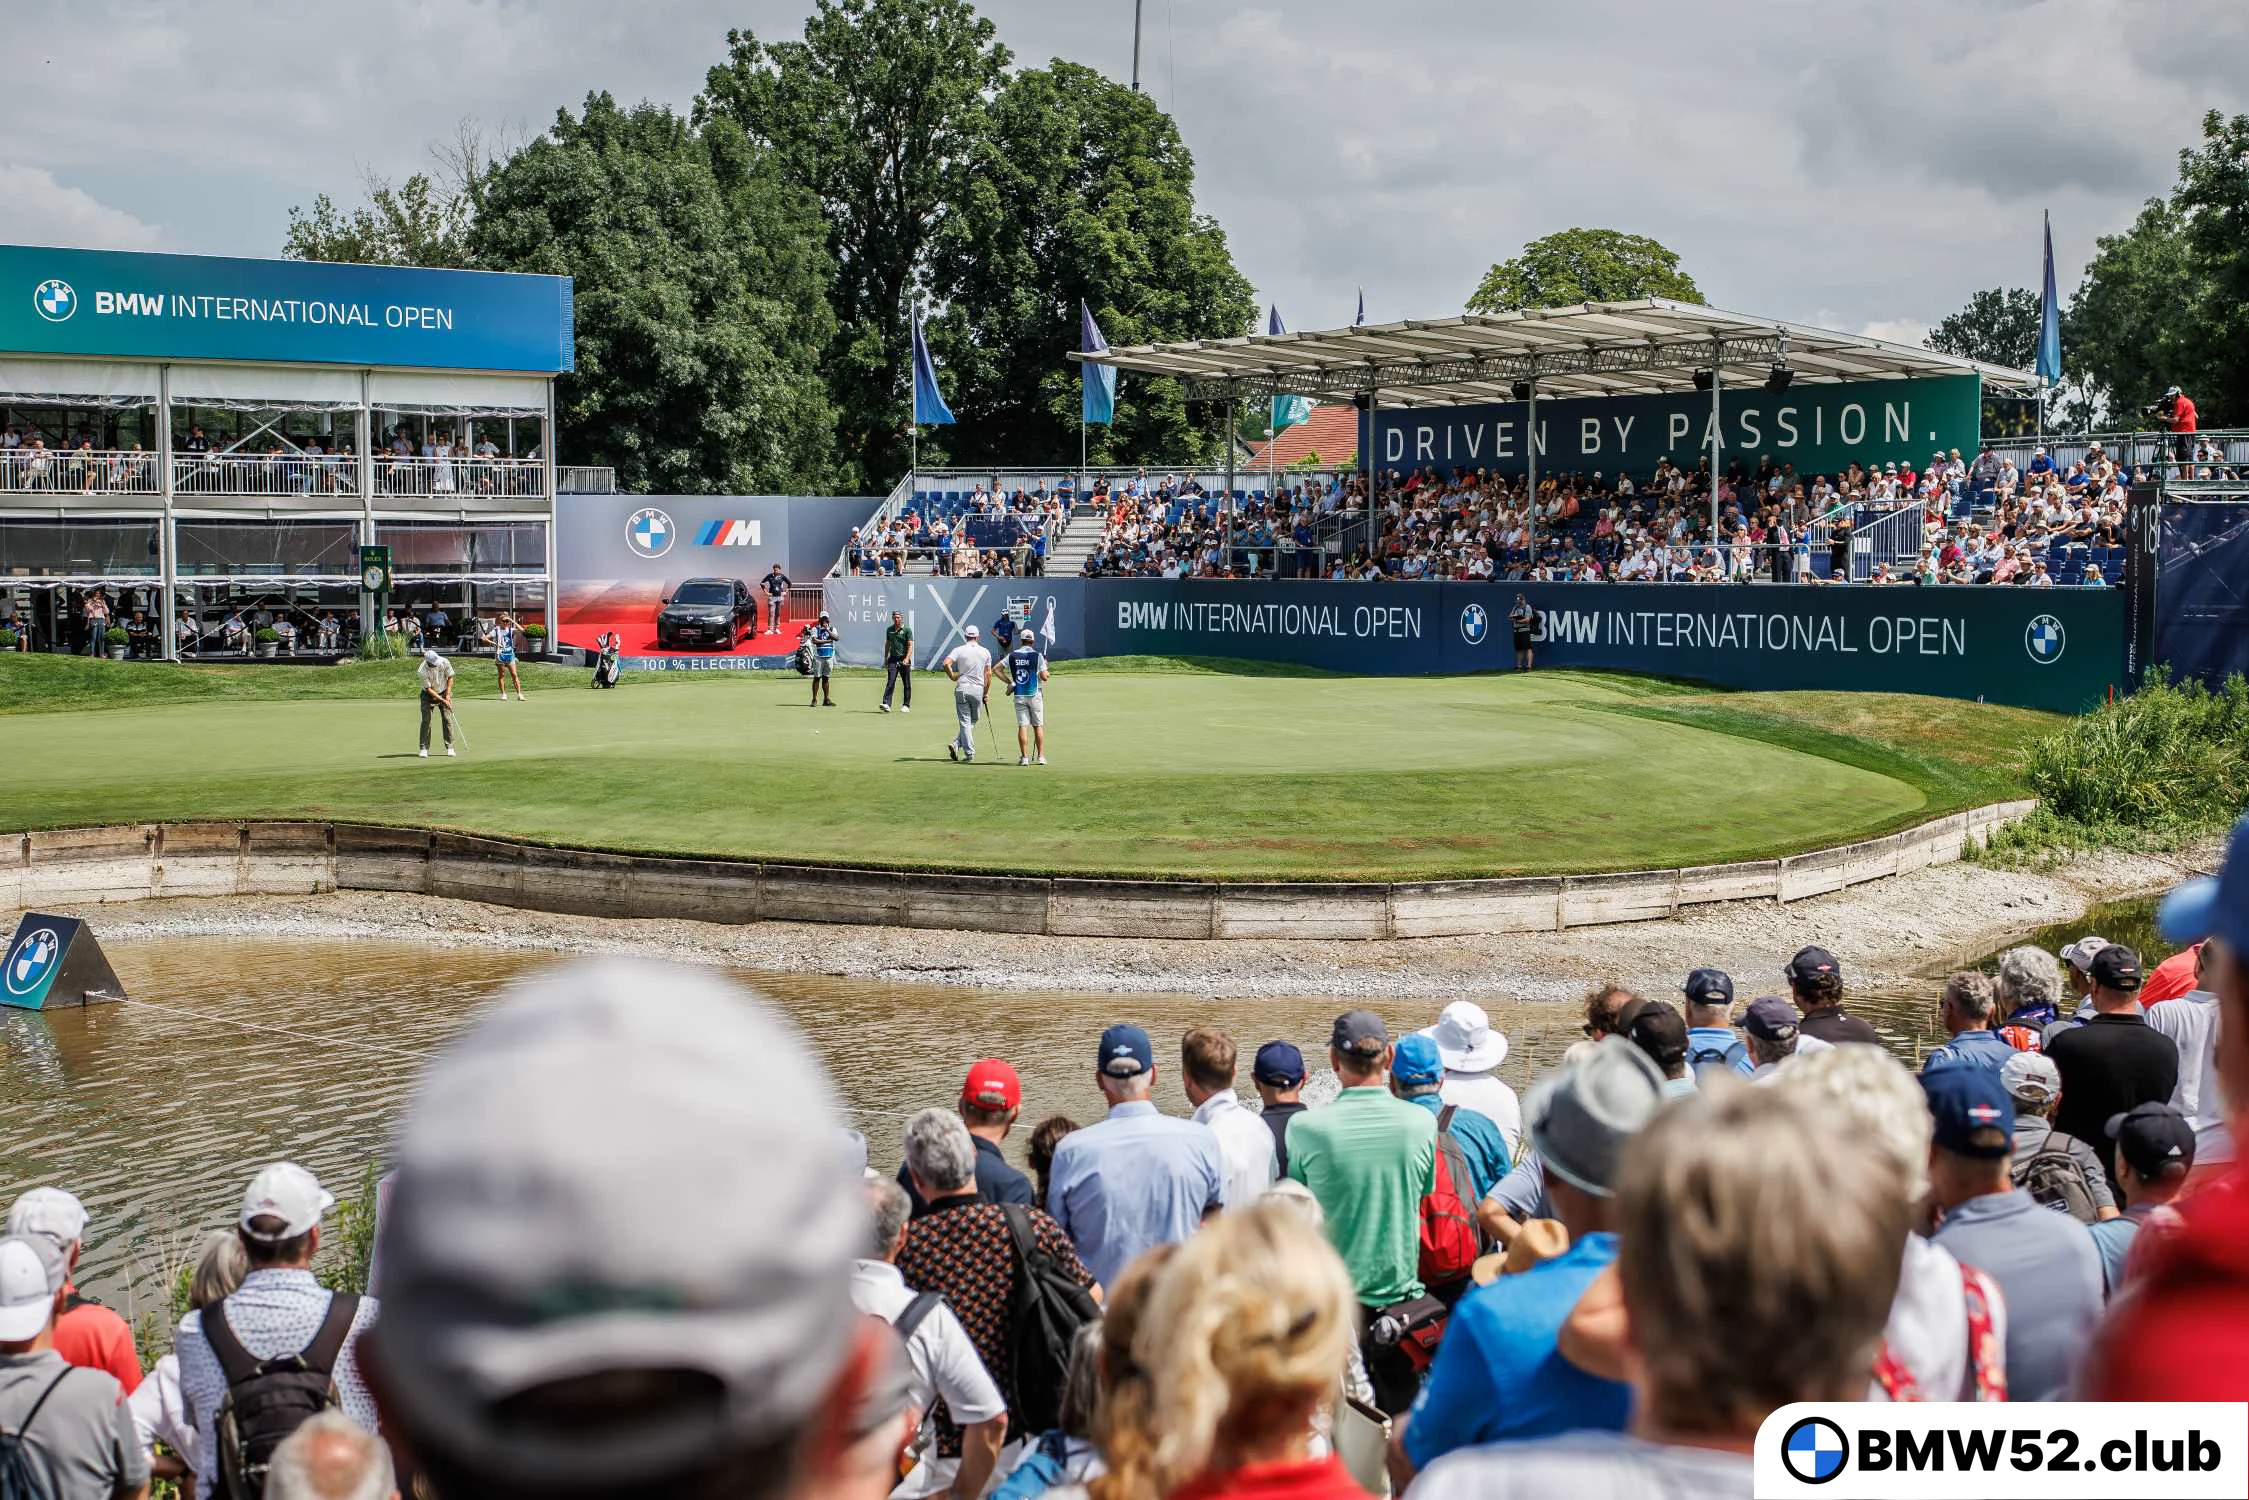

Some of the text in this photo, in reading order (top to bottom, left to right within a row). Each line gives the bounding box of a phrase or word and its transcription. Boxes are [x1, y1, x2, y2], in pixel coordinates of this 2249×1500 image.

[95, 291, 452, 330] BMW INTERNATIONAL OPEN
[1386, 401, 1936, 462] DRIVEN BY PASSION.
[631, 511, 669, 525] BMW
[2142, 503, 2158, 553] 18
[848, 594, 888, 607] THE
[848, 610, 888, 622] NEW
[1118, 602, 1421, 638] BMW INTERNATIONAL OPEN
[1530, 610, 1965, 655] BMW INTERNATIONAL OPEN
[641, 658, 760, 671] 100 % ELECTRIC
